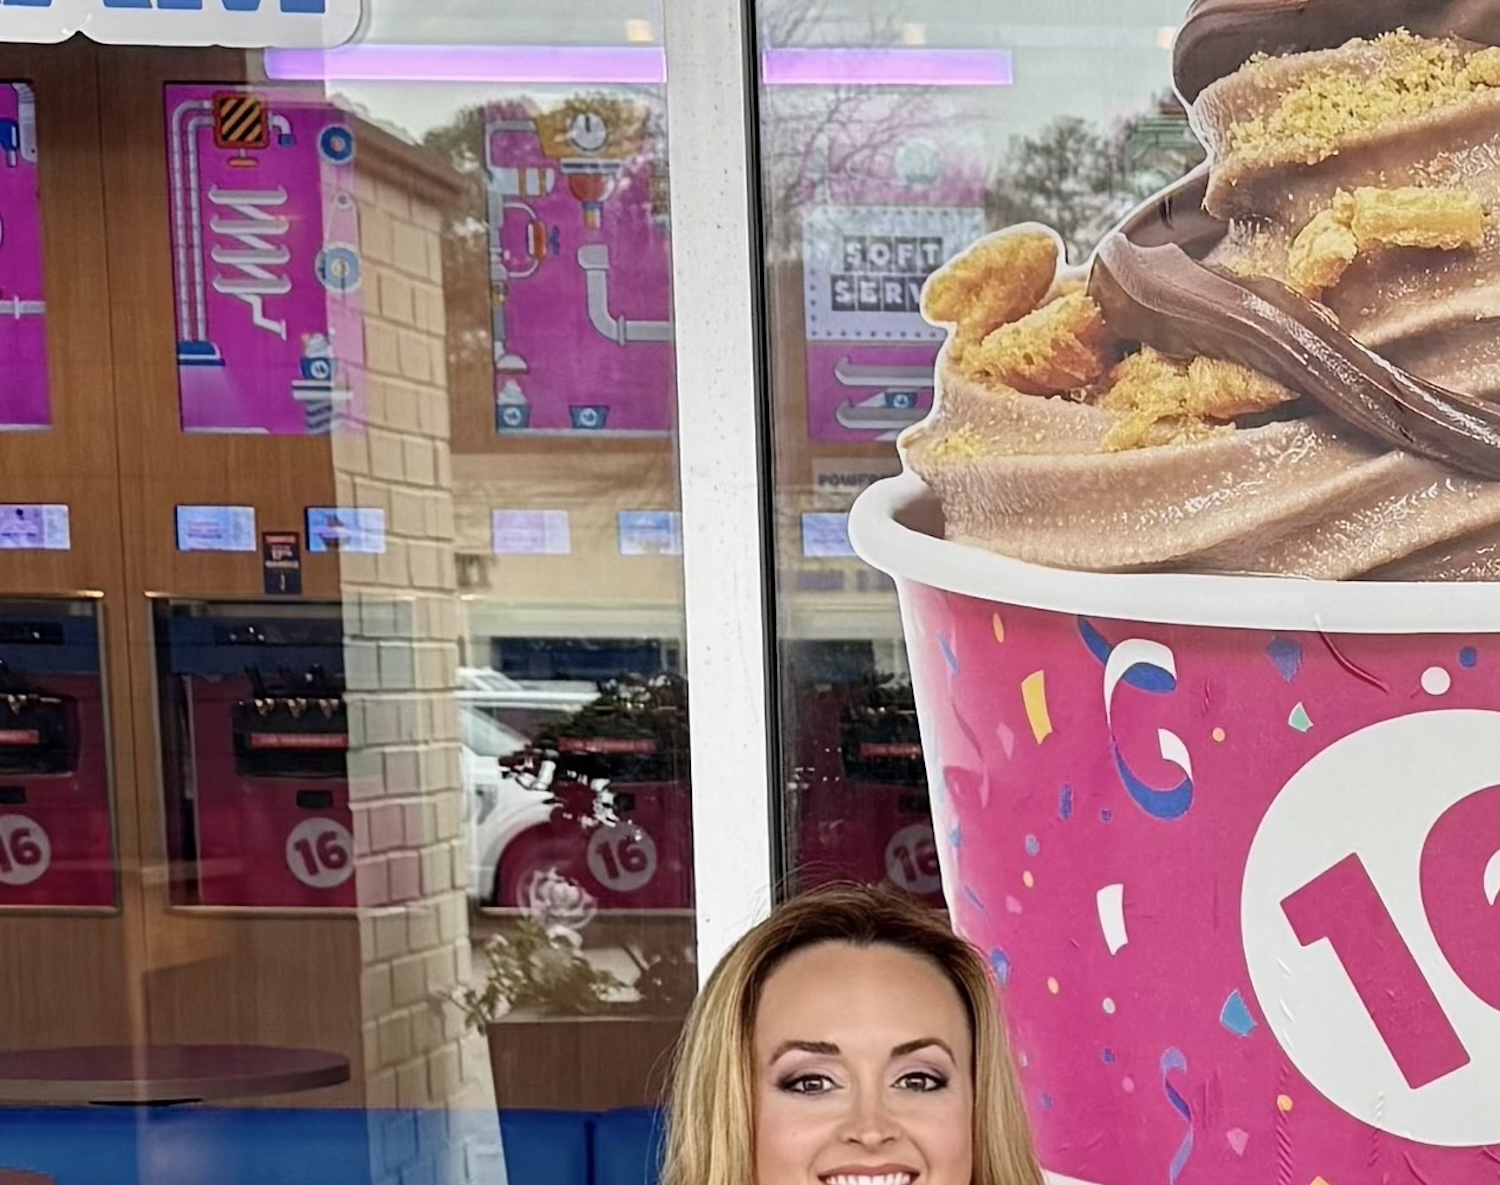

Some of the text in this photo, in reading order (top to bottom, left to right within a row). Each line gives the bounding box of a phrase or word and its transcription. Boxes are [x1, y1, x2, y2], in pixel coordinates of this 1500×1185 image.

[845, 242, 939, 267] SOFT
[293, 831, 348, 876] 16
[595, 835, 648, 879] 16
[894, 838, 939, 882] 16
